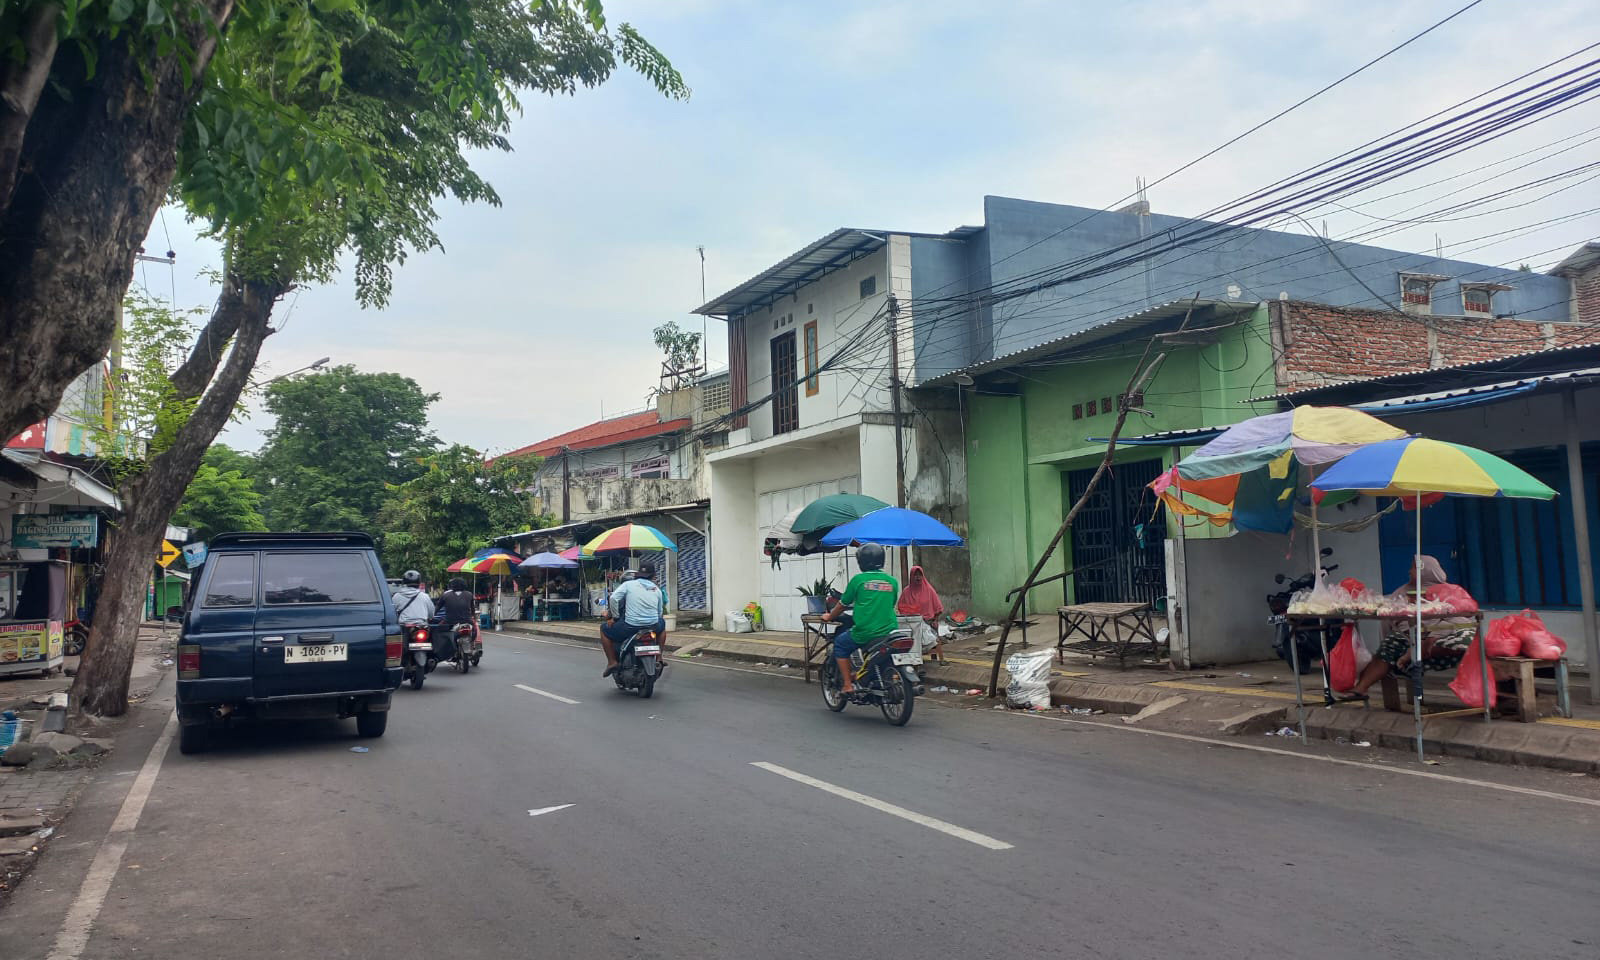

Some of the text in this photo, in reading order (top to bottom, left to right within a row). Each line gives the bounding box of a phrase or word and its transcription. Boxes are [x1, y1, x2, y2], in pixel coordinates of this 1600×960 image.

[16, 526, 47, 535] DAGING
[69, 526, 94, 534] LOKAL
[286, 645, 345, 657] N 1626 PY
